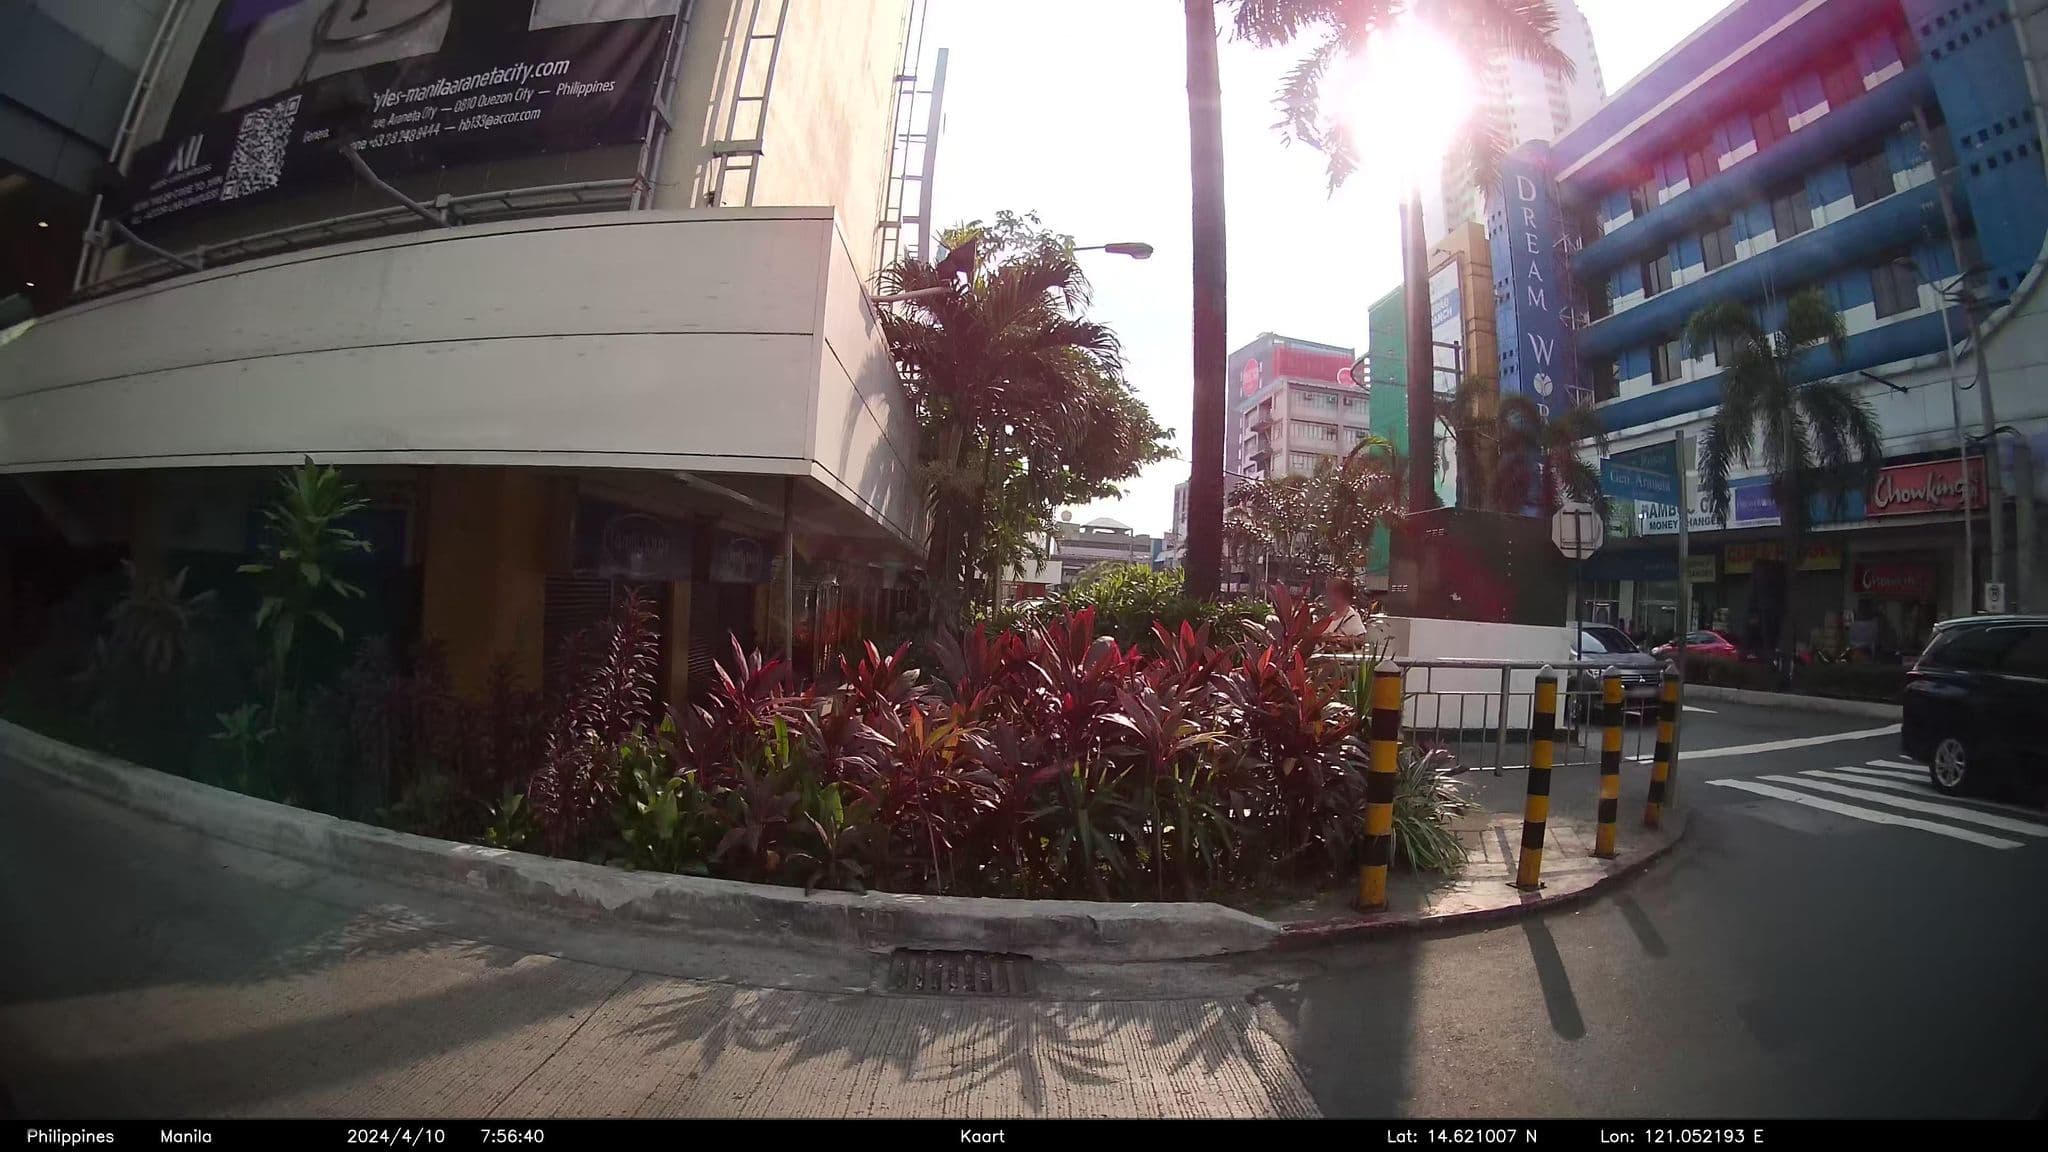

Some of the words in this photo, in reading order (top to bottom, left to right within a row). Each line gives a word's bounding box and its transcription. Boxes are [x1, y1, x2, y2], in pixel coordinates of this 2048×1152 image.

[421, 105, 437, 121] City
[454, 97, 477, 113] 0810
[478, 91, 513, 108] Quezon
[514, 87, 535, 103] City
[555, 79, 615, 98] Philippines
[1516, 175, 1548, 312] DREAM
[1874, 471, 1969, 508] Chowking
[1649, 519, 1678, 531] MONEY
